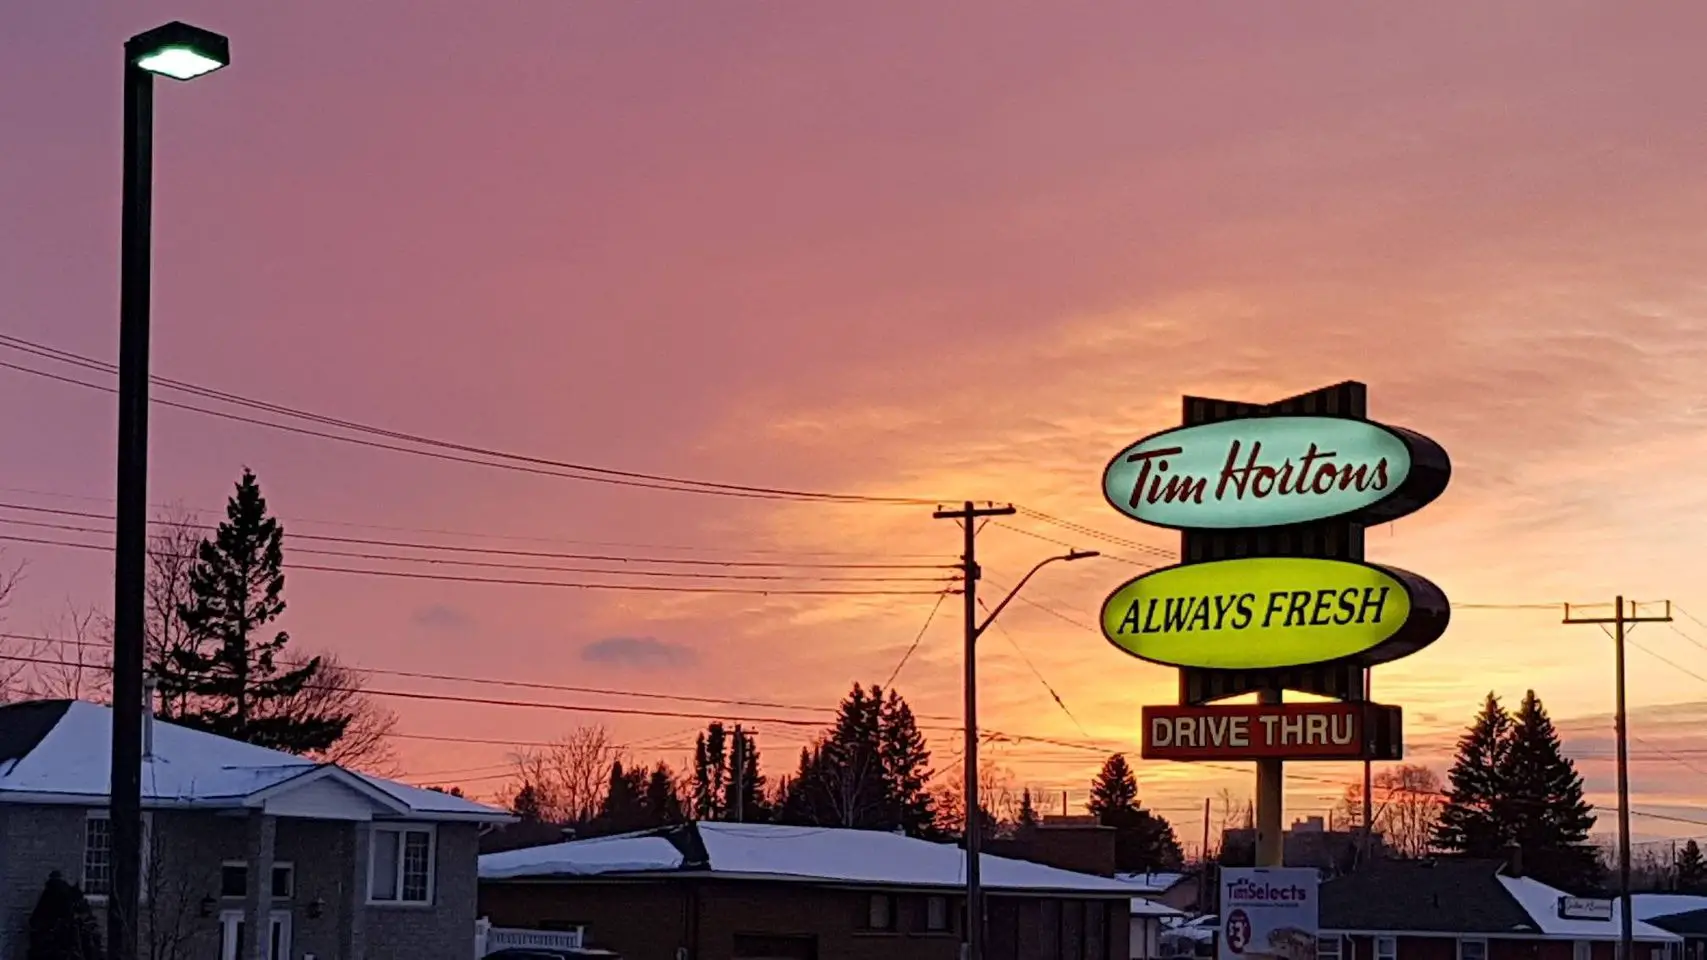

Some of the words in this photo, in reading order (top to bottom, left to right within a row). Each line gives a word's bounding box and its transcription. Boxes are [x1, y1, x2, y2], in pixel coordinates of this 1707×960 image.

[1126, 446, 1208, 509] Tim
[1215, 440, 1389, 501] Hortons
[1116, 592, 1255, 634] ALWAYS
[1261, 586, 1390, 628] FRESH
[1151, 715, 1250, 747] DRIVE
[1258, 713, 1354, 746] THRU
